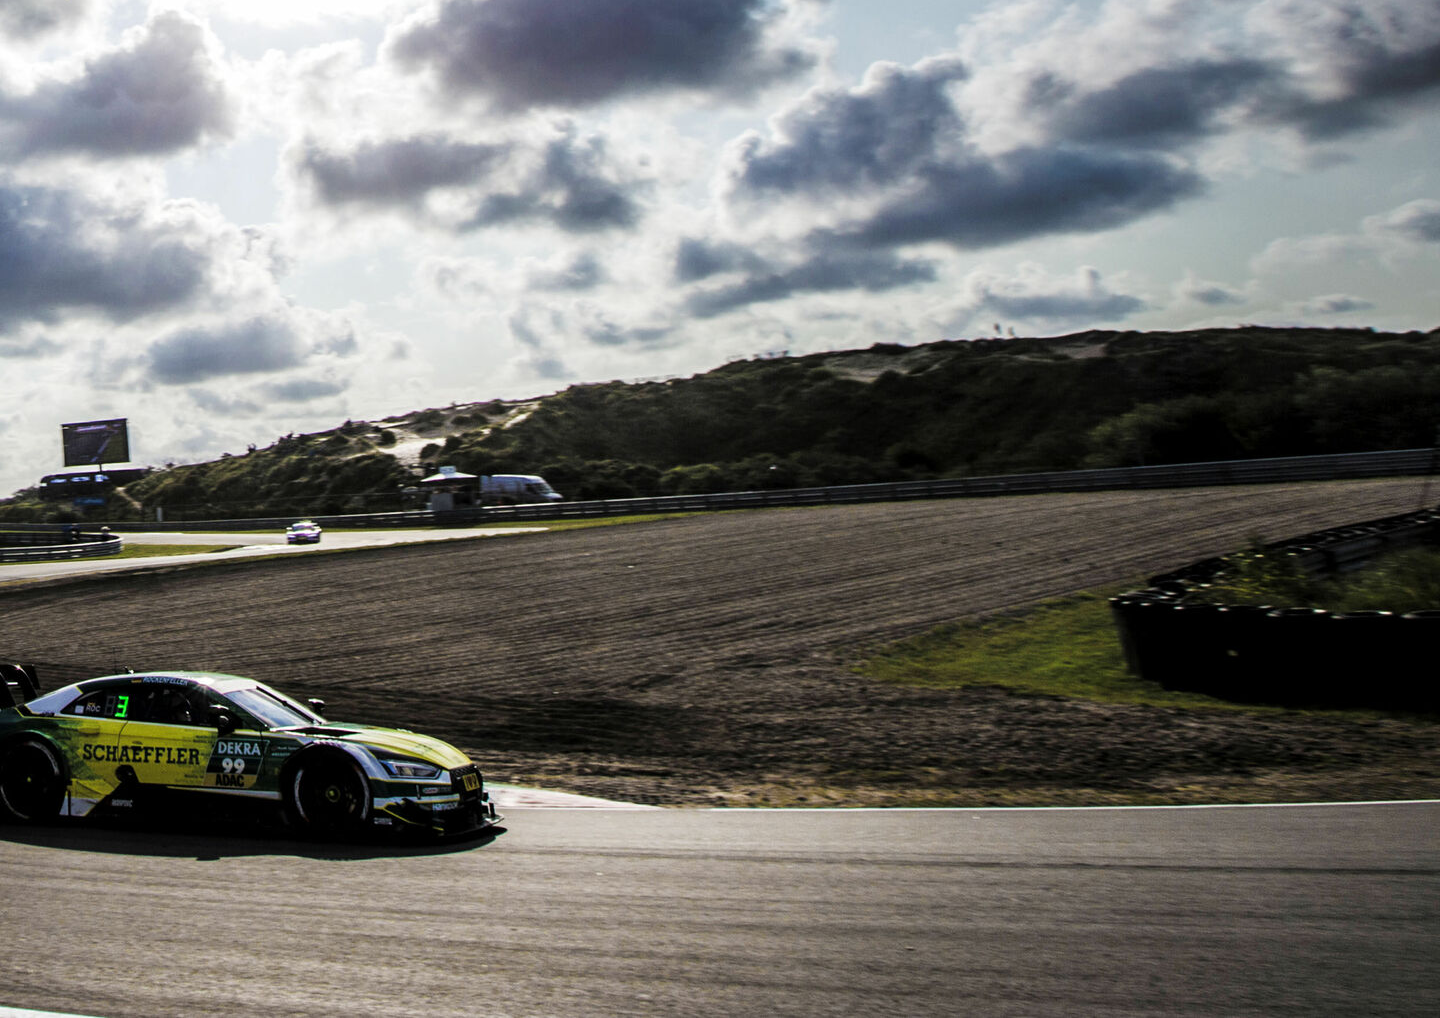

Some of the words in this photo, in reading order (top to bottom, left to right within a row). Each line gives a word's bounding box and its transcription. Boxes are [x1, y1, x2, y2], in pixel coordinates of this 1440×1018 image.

[114, 695, 130, 718] 3
[82, 744, 200, 765] SCHAEFFLER
[217, 741, 261, 756] DEKRA
[221, 757, 246, 774] 99
[216, 774, 244, 787] ADAC
